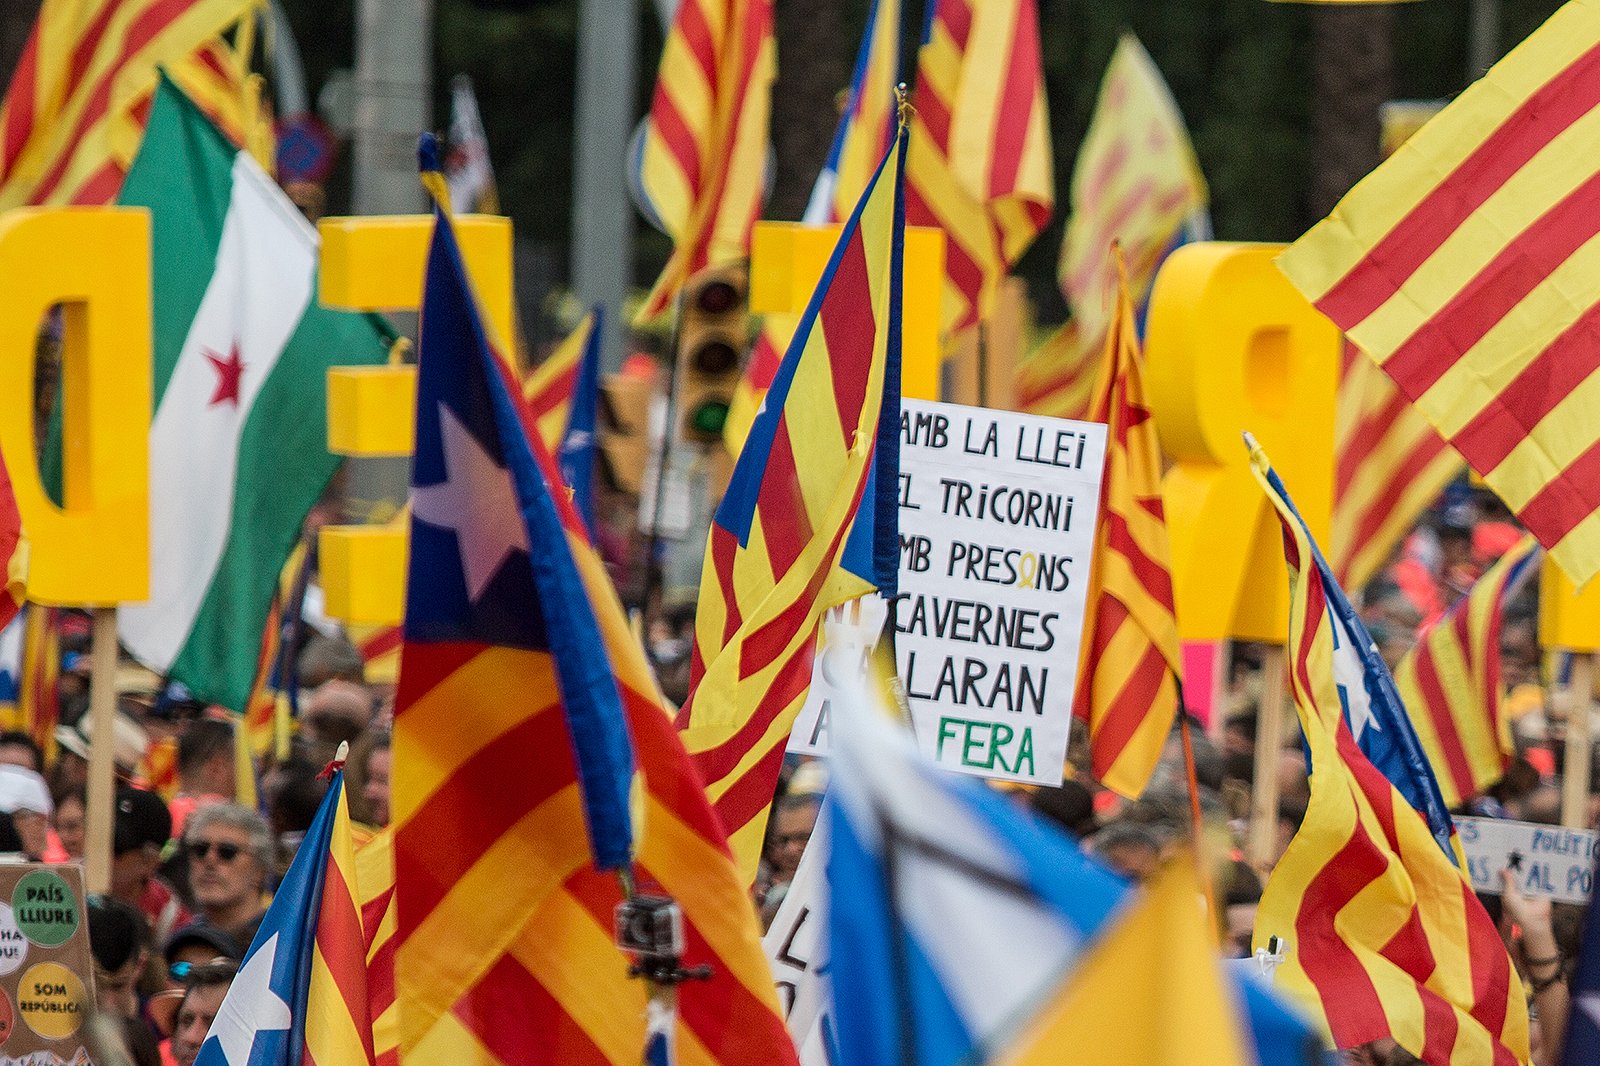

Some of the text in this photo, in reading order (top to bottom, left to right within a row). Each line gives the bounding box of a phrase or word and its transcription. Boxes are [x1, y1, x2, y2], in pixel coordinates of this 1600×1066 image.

[900, 408, 950, 449] AMB
[963, 417, 999, 458] LA
[895, 592, 1060, 652] CAVERNES
[936, 715, 1035, 777] FERA
[1525, 862, 1557, 893] AL
[26, 883, 65, 903] PAÍS
[19, 908, 74, 925] LLIURE
[34, 982, 68, 996] SOM
[20, 998, 82, 1014] REPÚBLICA
